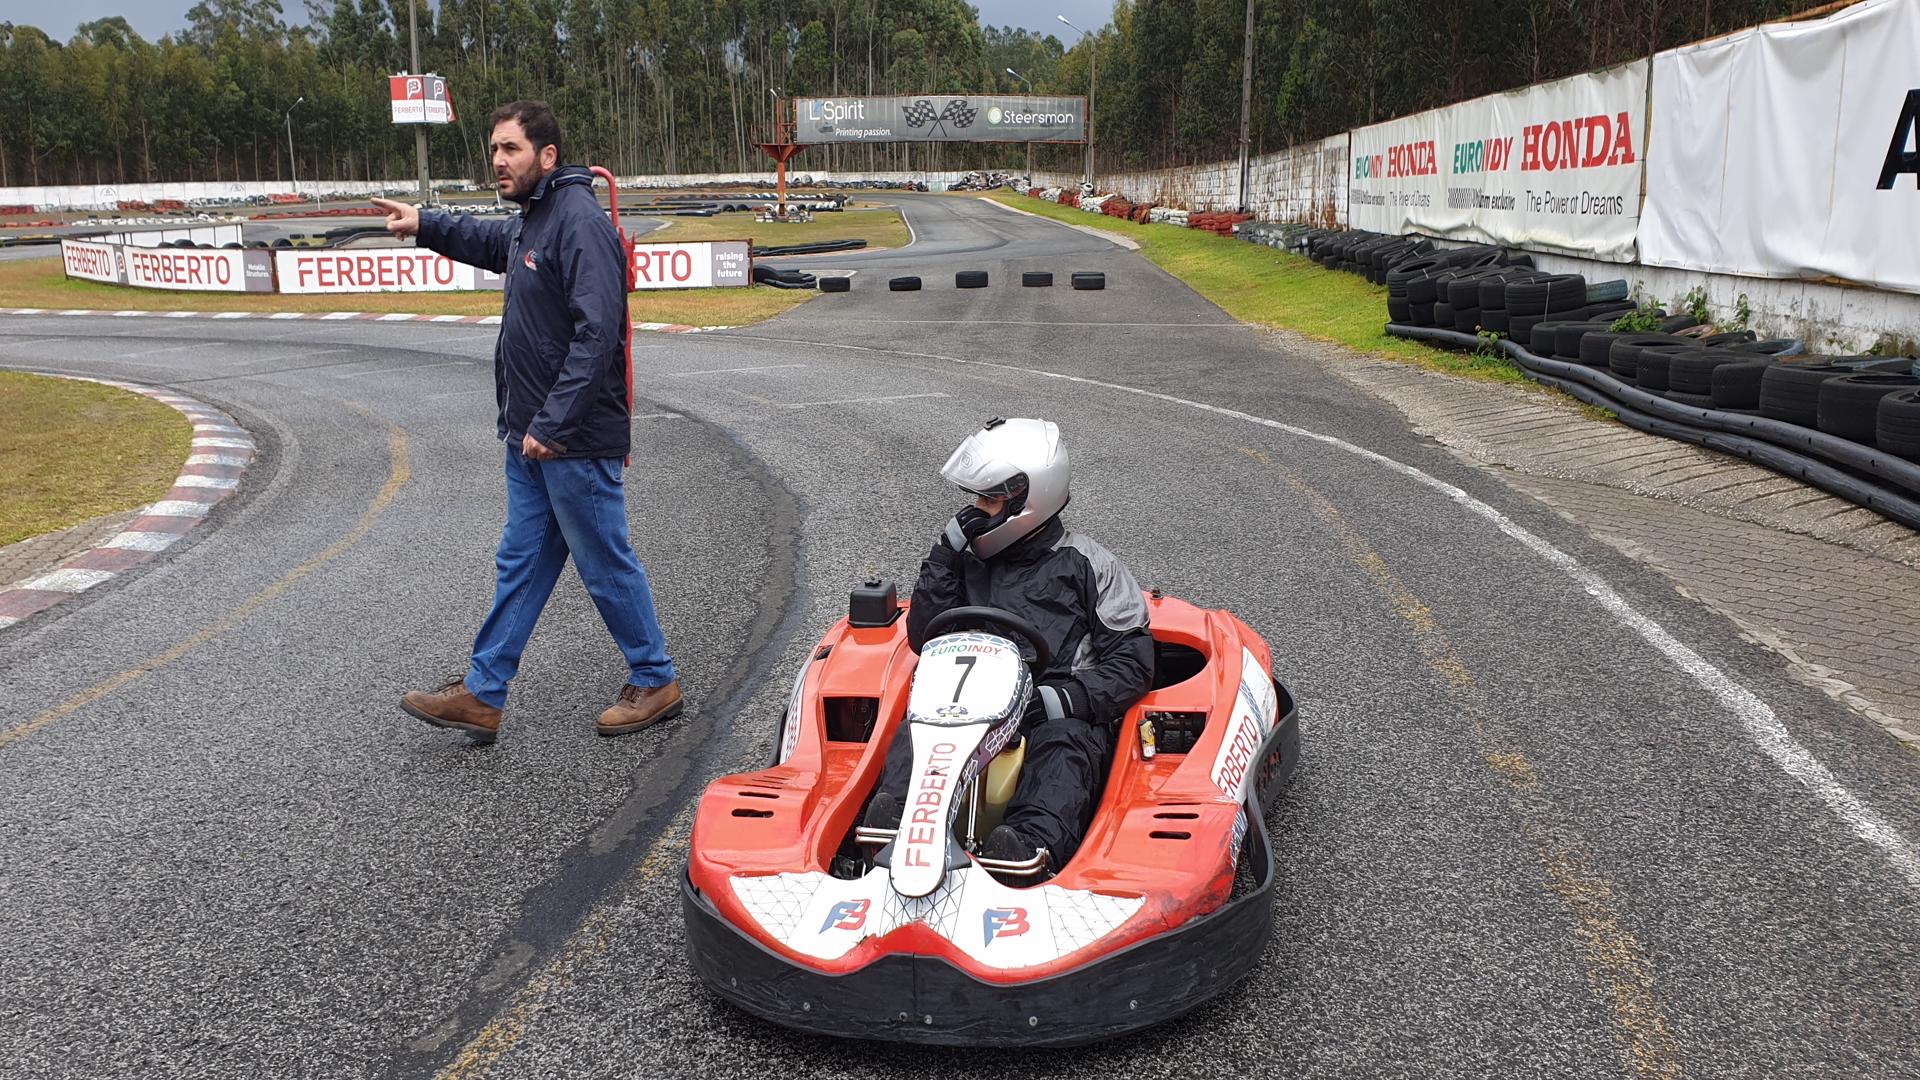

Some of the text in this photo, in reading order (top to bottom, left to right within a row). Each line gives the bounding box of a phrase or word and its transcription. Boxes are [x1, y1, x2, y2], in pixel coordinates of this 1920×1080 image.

[394, 106, 422, 114] FERBERTO
[1004, 110, 1074, 124] Steersman
[835, 127, 863, 138] Printing
[1521, 111, 1635, 171] HONDA
[1387, 140, 1438, 178] HONDA
[1526, 190, 1542, 213] The
[1543, 190, 1569, 214] Power
[1581, 190, 1623, 216] Dreams
[66, 245, 111, 277] FERBERTO
[132, 252, 231, 285] FERBERTO
[715, 252, 743, 261] raising
[722, 261, 737, 269] the
[297, 255, 454, 287] FERBERTO
[717, 269, 743, 278] future
[930, 644, 1002, 657] EUROINDY
[952, 656, 977, 703] 7
[905, 742, 957, 867] FERBERTO
